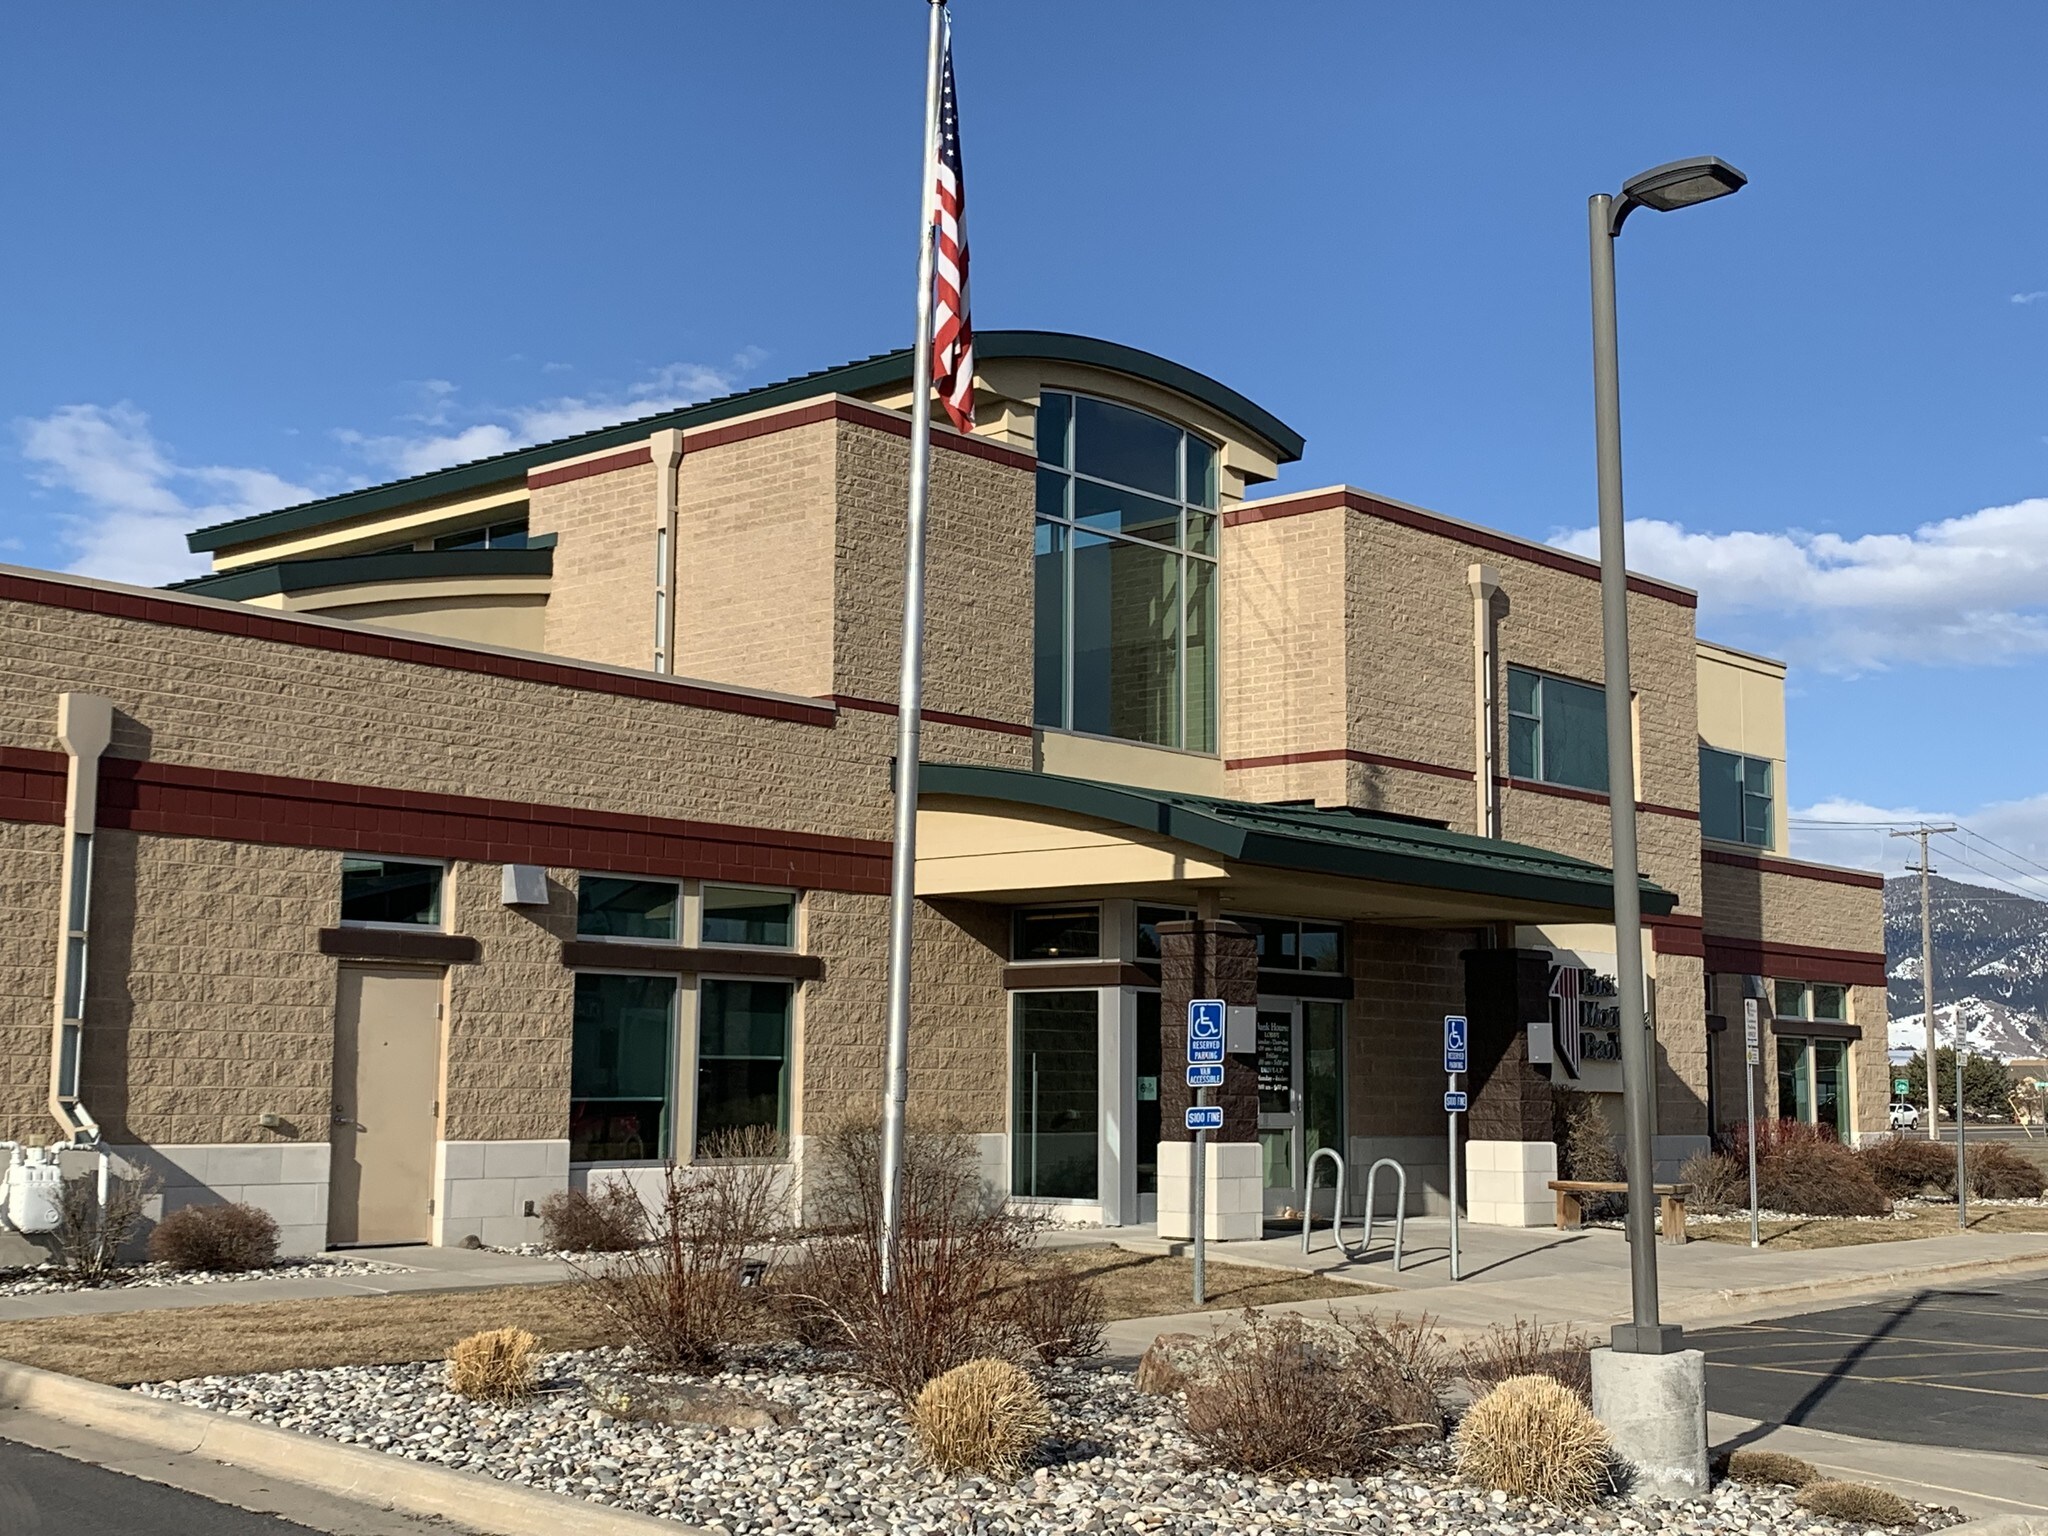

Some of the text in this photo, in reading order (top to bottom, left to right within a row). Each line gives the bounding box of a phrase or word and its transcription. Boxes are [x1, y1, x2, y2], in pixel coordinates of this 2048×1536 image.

[1579, 968, 1618, 997] First
[1192, 1040, 1220, 1050] RESERVED
[1194, 1051, 1218, 1060] PARKING
[1200, 1067, 1211, 1075] VAN
[1190, 1075, 1220, 1084] ACCESSIBLE
[1188, 1112, 1221, 1124] $100 FINE
